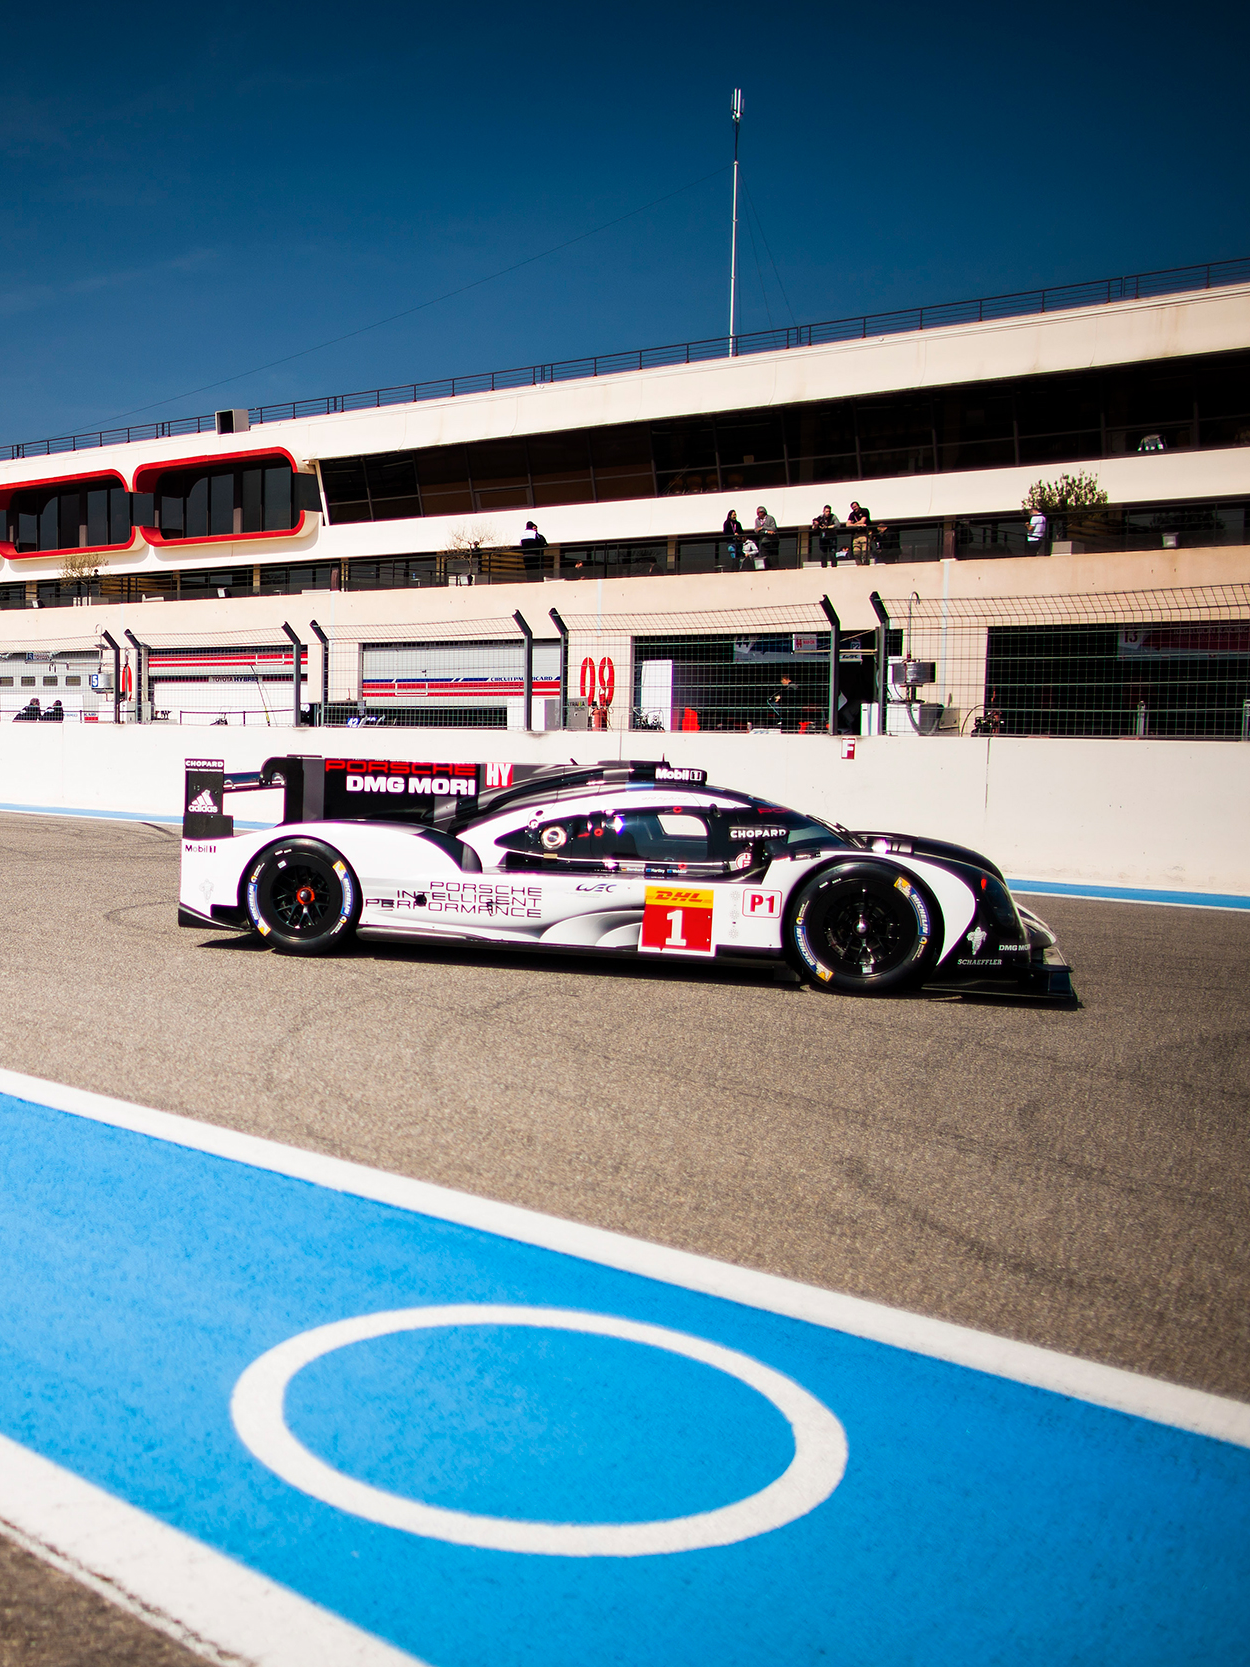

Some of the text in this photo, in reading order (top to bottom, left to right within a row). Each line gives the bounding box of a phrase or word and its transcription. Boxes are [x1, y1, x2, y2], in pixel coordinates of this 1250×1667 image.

[92, 675, 98, 687] 5
[580, 657, 615, 706] 09
[348, 717, 359, 728] 42
[841, 739, 855, 758] F
[185, 760, 224, 768] CHOPARD
[325, 760, 476, 776] PORSCHE
[486, 762, 512, 786] HY
[655, 768, 690, 781] Mobil
[346, 775, 476, 796] DMG MORI
[188, 804, 218, 814] adidas
[730, 829, 787, 839] CHOPARD
[185, 845, 208, 853] Mobil
[429, 881, 542, 898] PORSCHE
[575, 883, 617, 893] WEC
[654, 890, 704, 903] DHL
[749, 894, 775, 914] P1
[910, 893, 928, 935] MICHELIN
[665, 909, 687, 947] 1
[957, 958, 1002, 966] SCHAEFFLER
